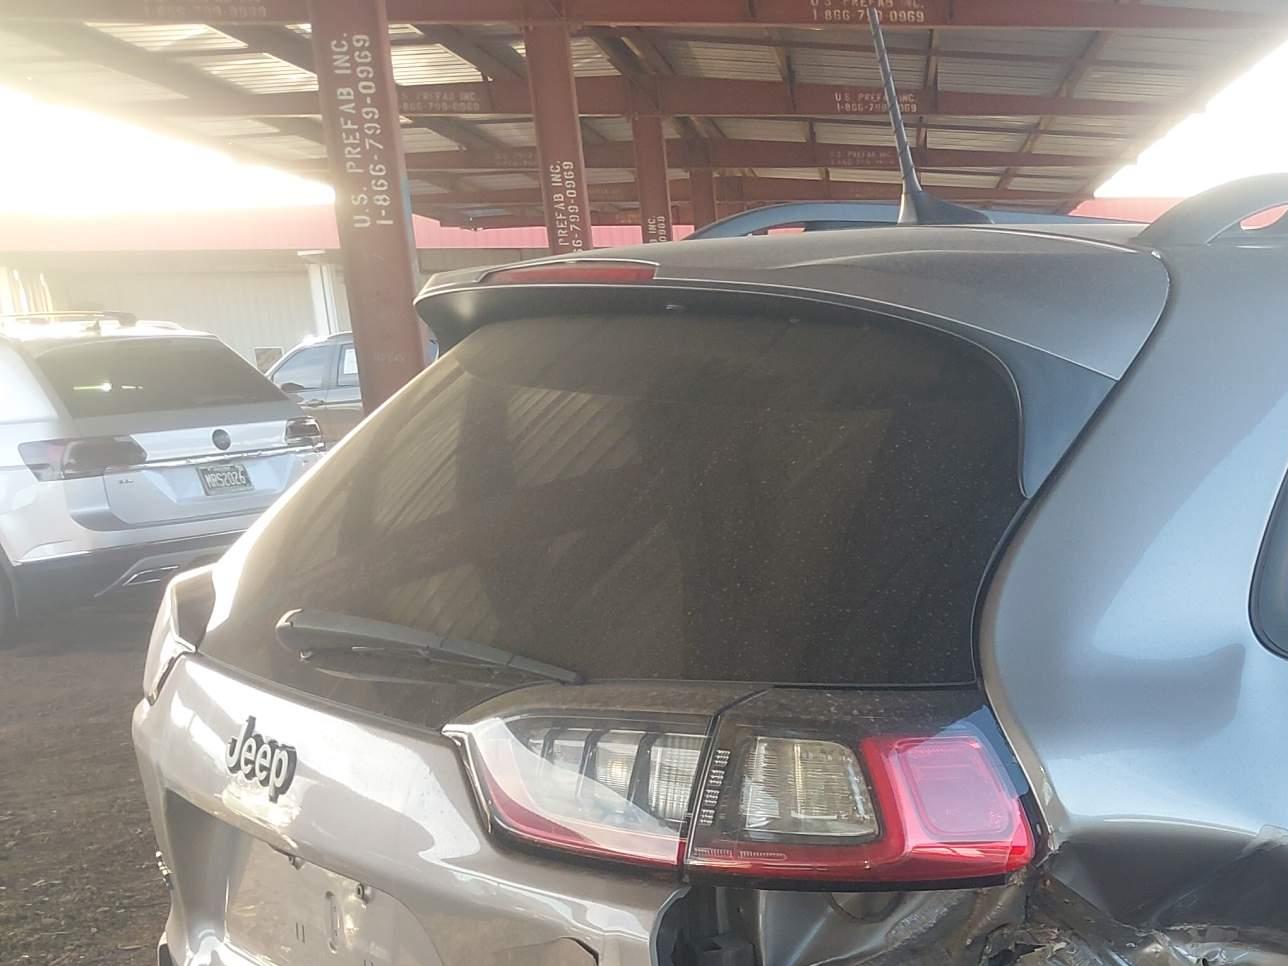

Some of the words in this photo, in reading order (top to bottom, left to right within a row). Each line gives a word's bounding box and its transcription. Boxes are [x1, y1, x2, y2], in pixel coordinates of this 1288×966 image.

[331, 33, 352, 74] INC.
[337, 87, 364, 174] PREFAB
[352, 34, 394, 225] 1-866-799-0969
[550, 160, 563, 186] INC.
[352, 186, 371, 227] U.S.
[553, 193, 570, 246] PREFAB
[205, 471, 246, 488] MRS2026
[225, 715, 298, 804] Jeep
